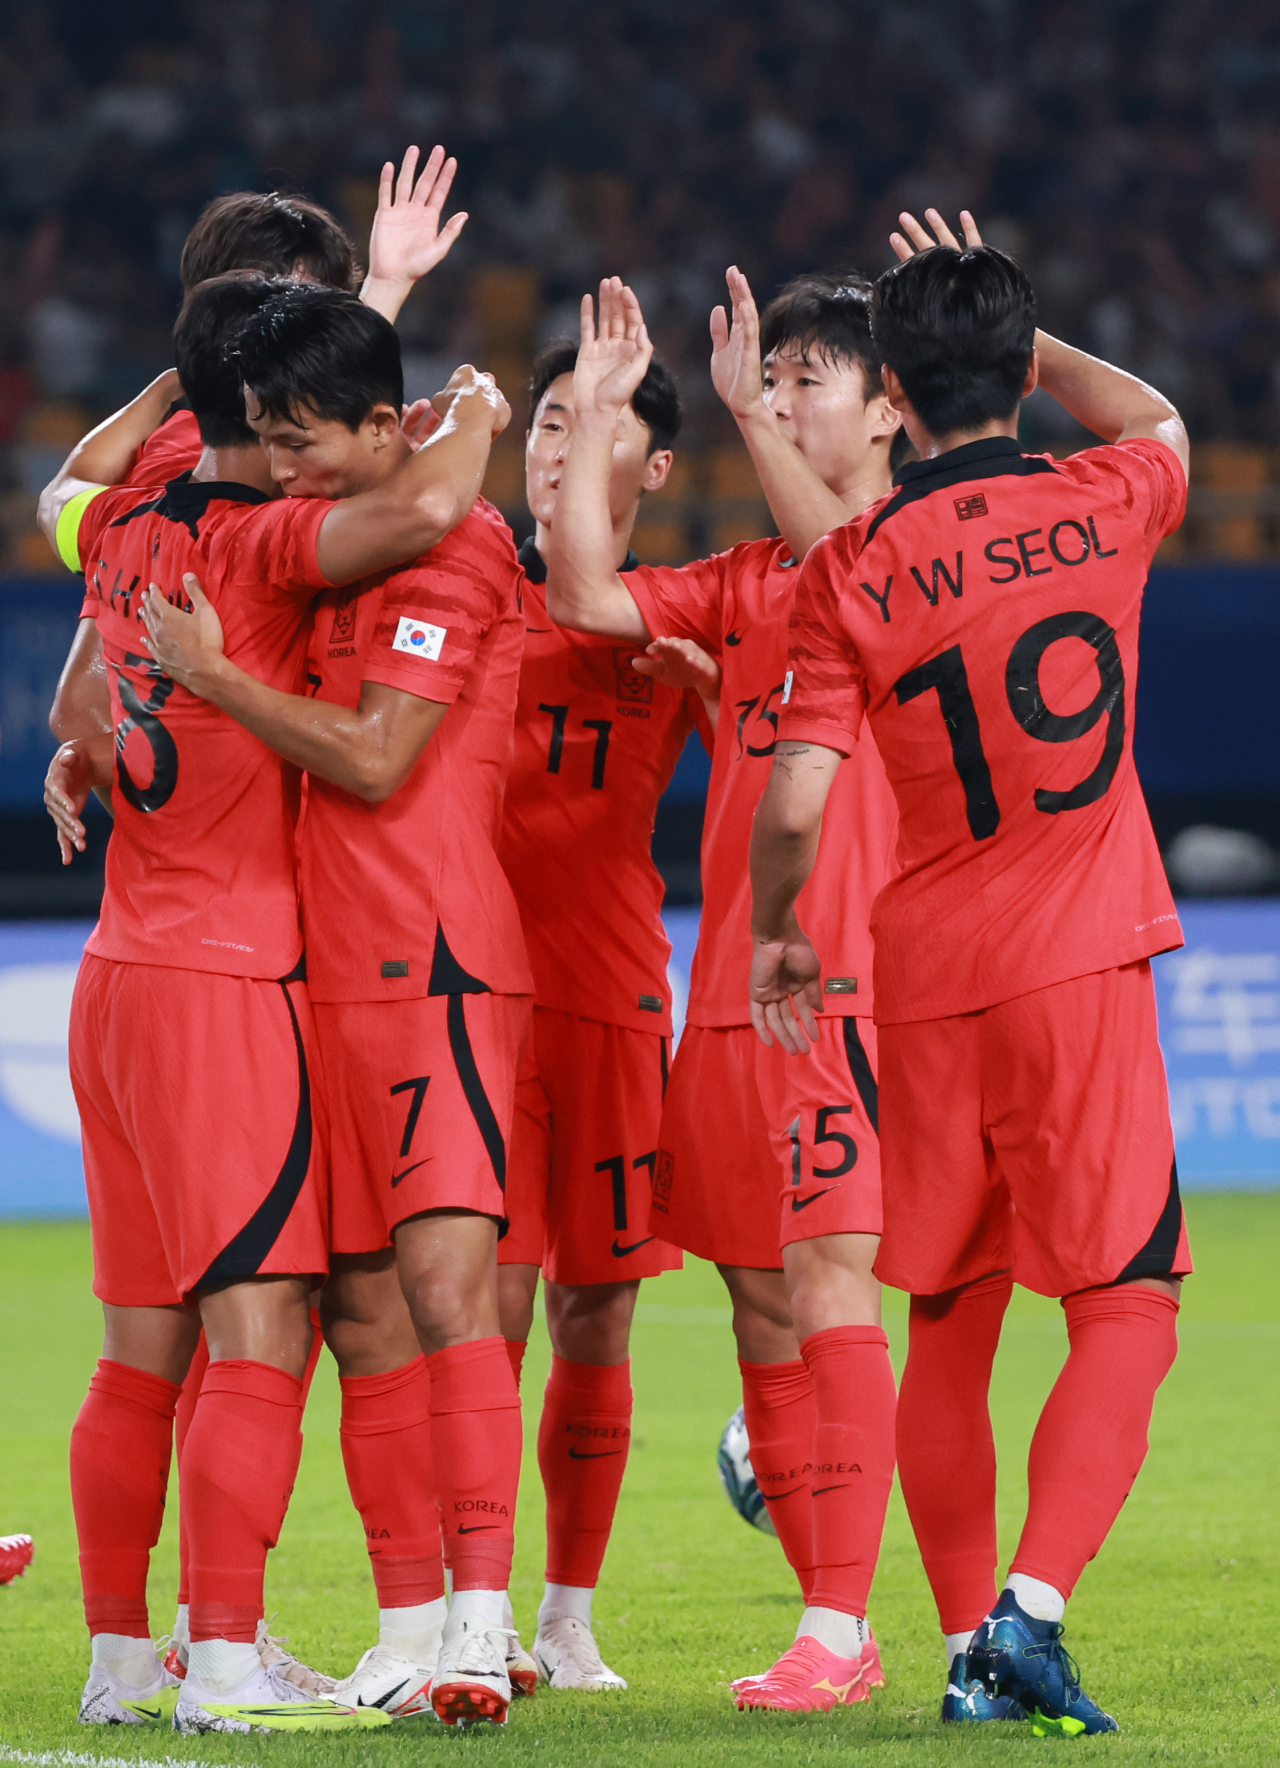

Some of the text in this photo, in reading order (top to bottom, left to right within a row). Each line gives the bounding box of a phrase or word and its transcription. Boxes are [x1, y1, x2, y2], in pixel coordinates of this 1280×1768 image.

[860, 515, 1118, 623] Y W SEOL
[328, 646, 357, 659] KOREA
[111, 652, 178, 813] 8
[538, 702, 613, 790] 11
[616, 705, 652, 719] KOREA
[893, 610, 1126, 841] 19
[390, 1075, 431, 1158] 7
[781, 1104, 858, 1187] 15
[565, 1423, 631, 1439] KOREA
[812, 1462, 862, 1476] OREA
[454, 1500, 508, 1517] KOREA
